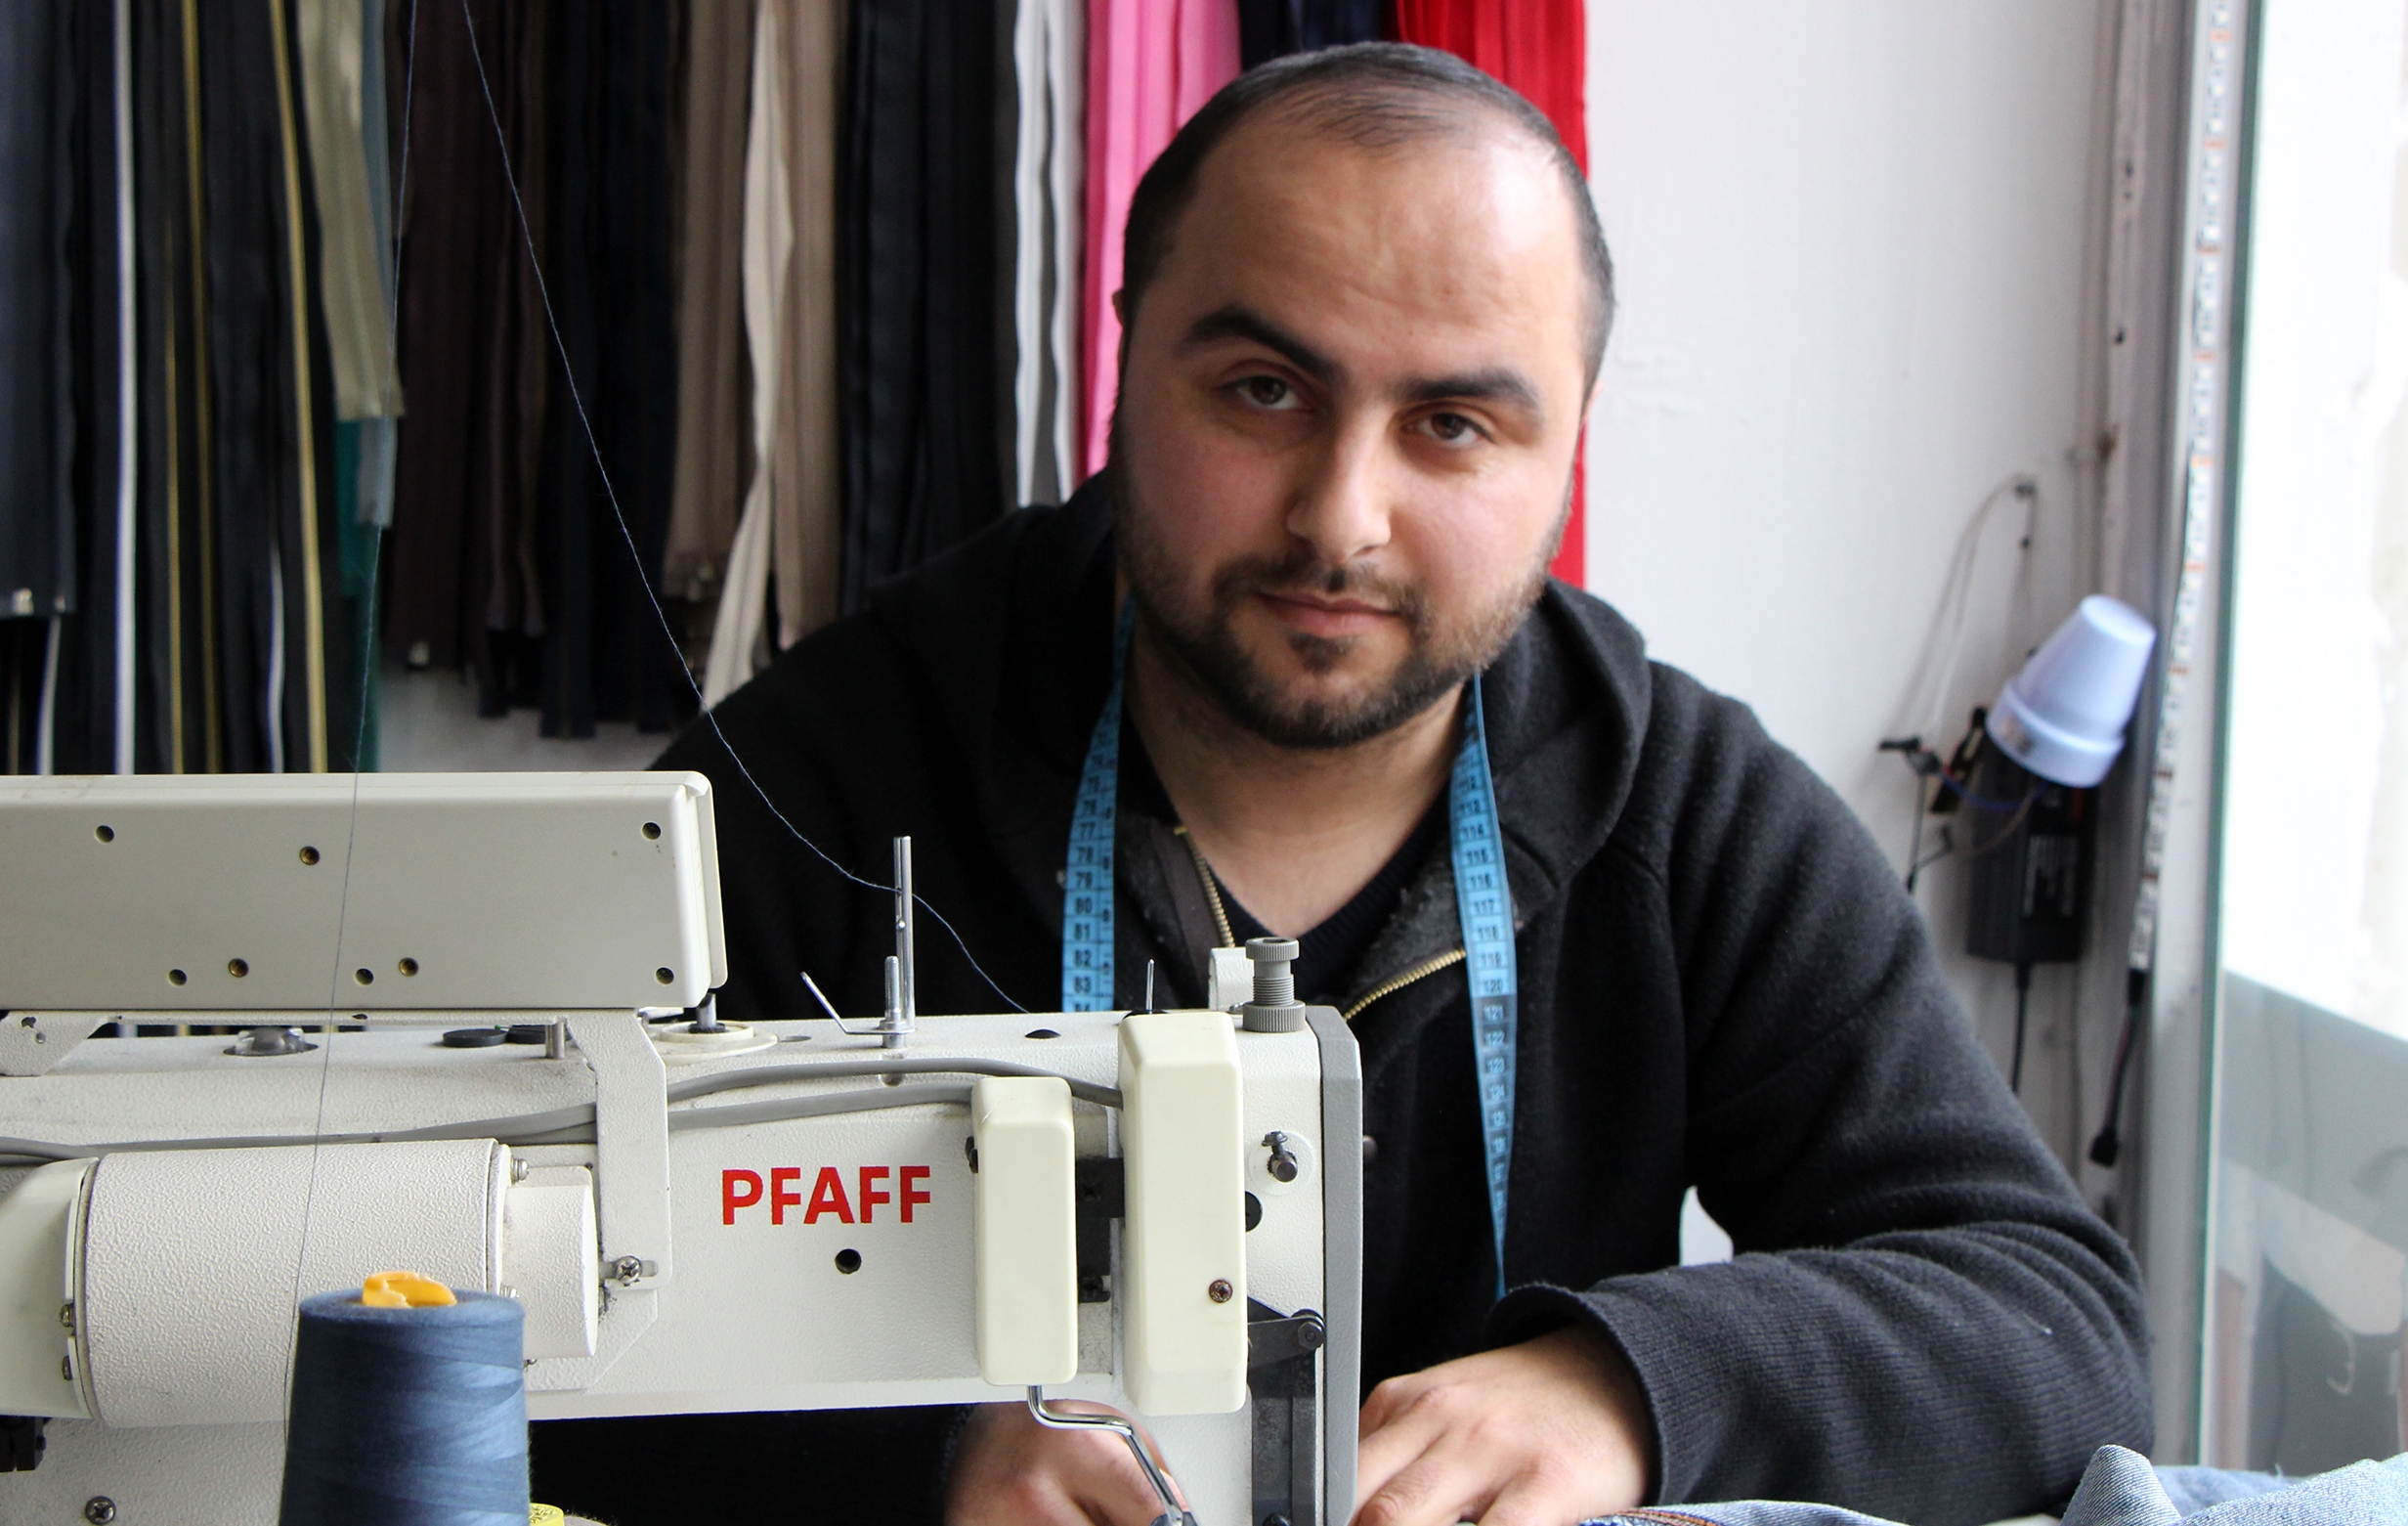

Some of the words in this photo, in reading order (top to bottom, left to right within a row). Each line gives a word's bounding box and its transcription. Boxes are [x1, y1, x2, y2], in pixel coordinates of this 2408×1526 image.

[1079, 821, 1096, 840] 77
[1074, 896, 1093, 915] 80
[1473, 898, 1495, 915] 117
[1073, 922, 1092, 941] 81
[1073, 948, 1092, 968] 82
[1073, 976, 1092, 994] 83
[1484, 979, 1505, 994] 120
[1484, 1004, 1504, 1021] 121
[1484, 1029, 1506, 1047] 122
[722, 1165, 931, 1226] PFAFF
